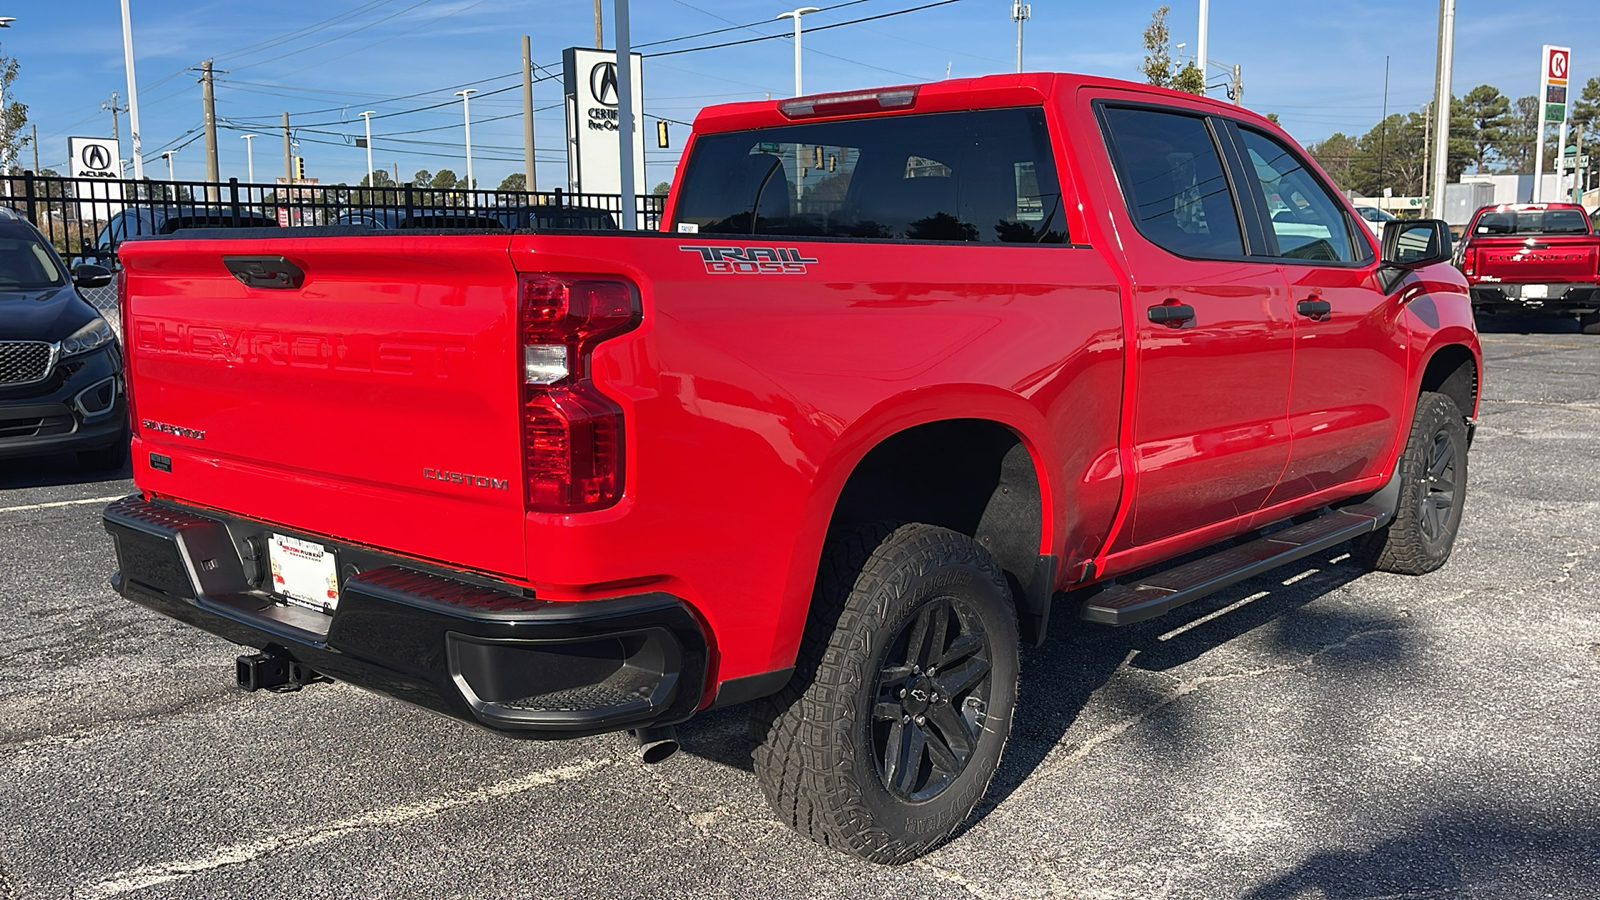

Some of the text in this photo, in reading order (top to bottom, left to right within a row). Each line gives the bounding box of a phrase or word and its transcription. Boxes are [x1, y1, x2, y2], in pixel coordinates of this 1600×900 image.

[588, 107, 635, 120] CERTIF
[588, 119, 635, 131] Pre-Ow
[79, 170, 117, 178] ACURA
[679, 245, 818, 263] TRAIL
[704, 261, 807, 274] BOSS
[137, 319, 467, 379] CHEVROLET
[423, 467, 509, 491] CUSTOM
[904, 757, 992, 835] GOODYEAR
